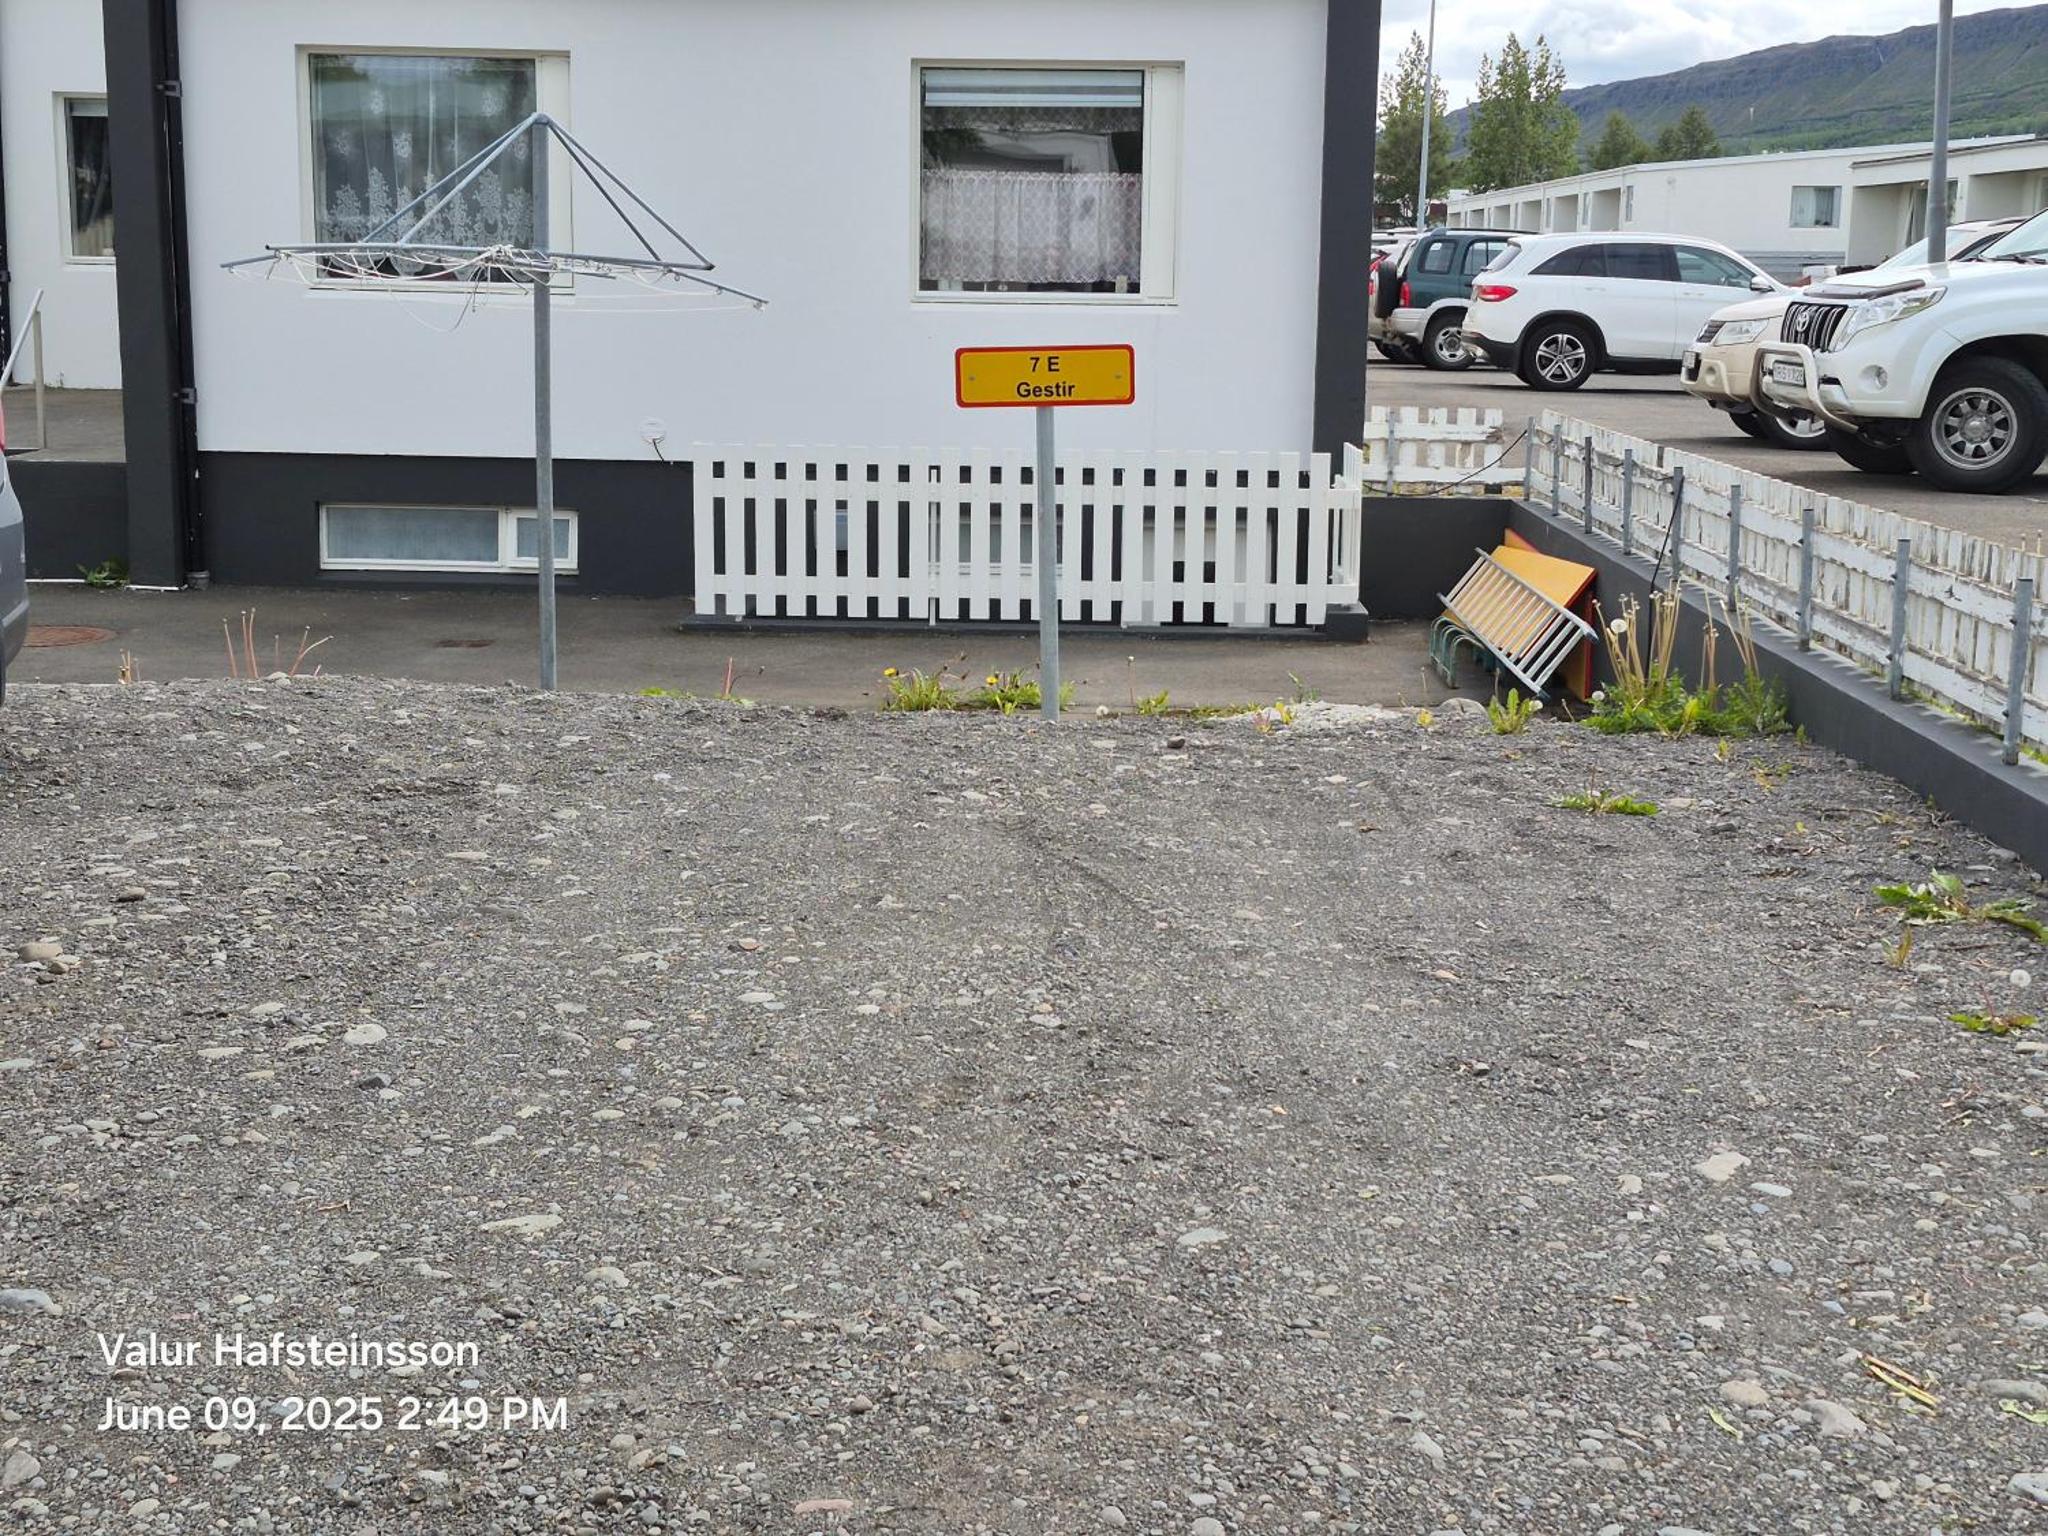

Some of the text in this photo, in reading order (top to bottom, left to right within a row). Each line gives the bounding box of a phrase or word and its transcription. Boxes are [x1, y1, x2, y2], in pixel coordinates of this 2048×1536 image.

[1029, 356, 1060, 373] 7 E
[1016, 381, 1076, 398] Gestir
